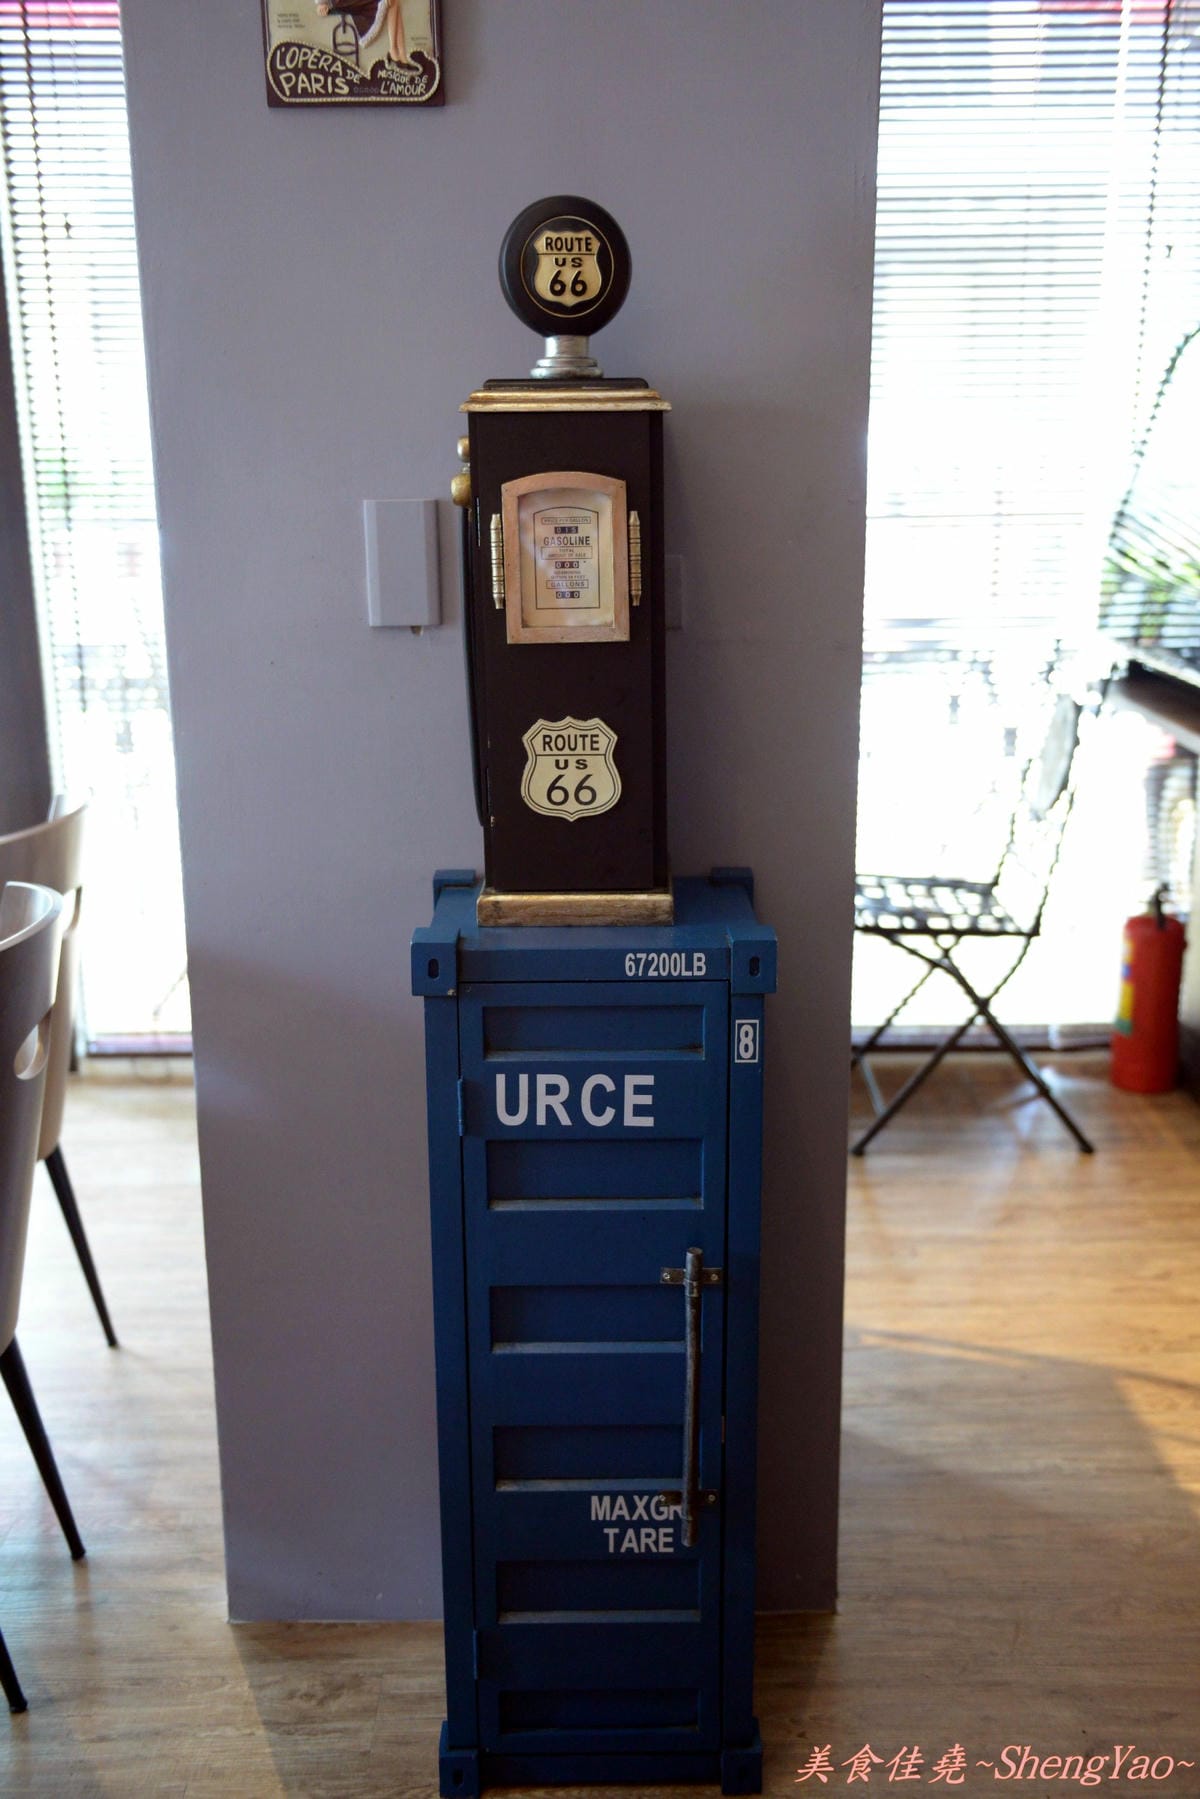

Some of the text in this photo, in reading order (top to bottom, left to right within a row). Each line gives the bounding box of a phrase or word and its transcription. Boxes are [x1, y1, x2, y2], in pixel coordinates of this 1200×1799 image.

[279, 72, 350, 96] PARIS
[345, 69, 361, 85] DE
[380, 80, 427, 96] L'AMOUR
[415, 74, 429, 84] DE
[545, 237, 592, 252] ROUTE
[549, 270, 587, 297] 66
[543, 536, 591, 546] GASOLINE
[543, 734, 600, 751] ROUTE
[546, 774, 597, 806] 66
[625, 953, 706, 977] 67200LB
[738, 1024, 755, 1059] 8
[495, 1073, 655, 1127] URCE
[603, 1528, 674, 1553] TARE
